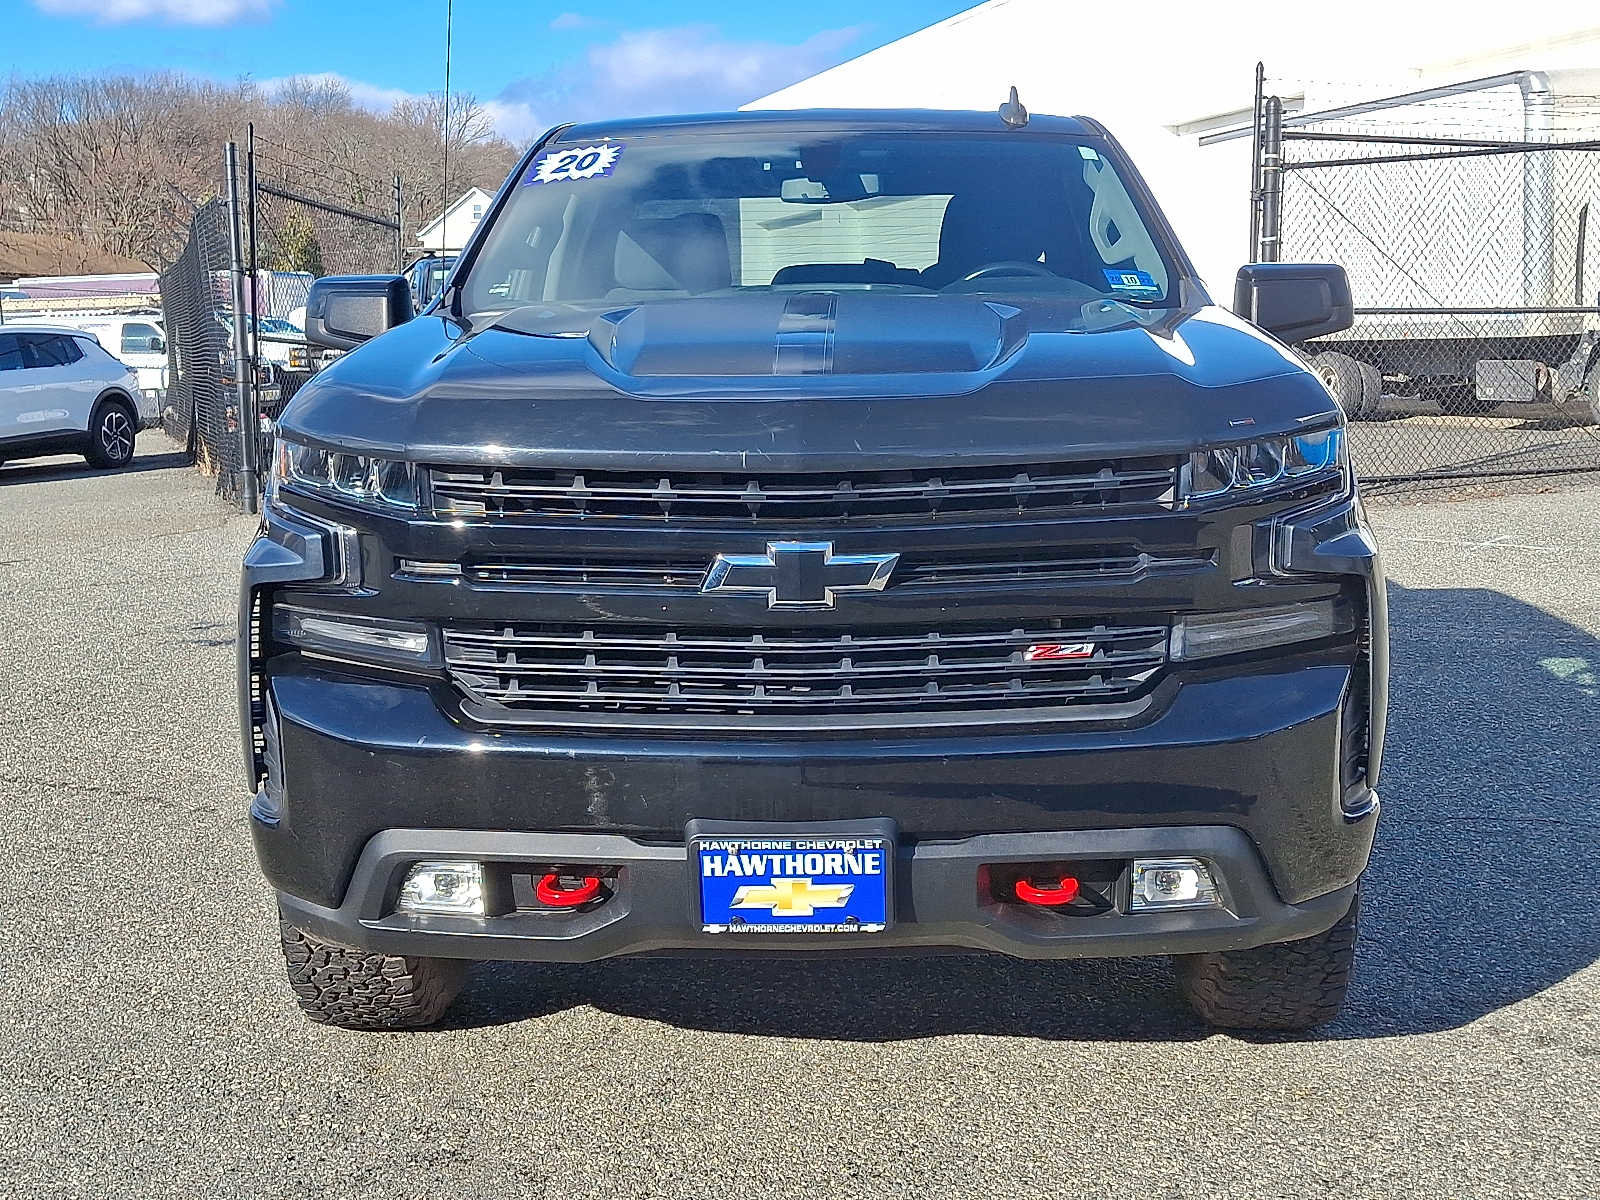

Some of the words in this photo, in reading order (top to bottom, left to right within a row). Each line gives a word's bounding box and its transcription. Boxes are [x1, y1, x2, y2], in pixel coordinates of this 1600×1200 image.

[551, 152, 600, 174] 20
[700, 841, 792, 850] HAWTHORNE
[796, 840, 882, 850] CHEVROLET
[703, 854, 881, 877] HAWTHORNE
[729, 925, 858, 933] HAWTHORNECHEVROLET.COM
